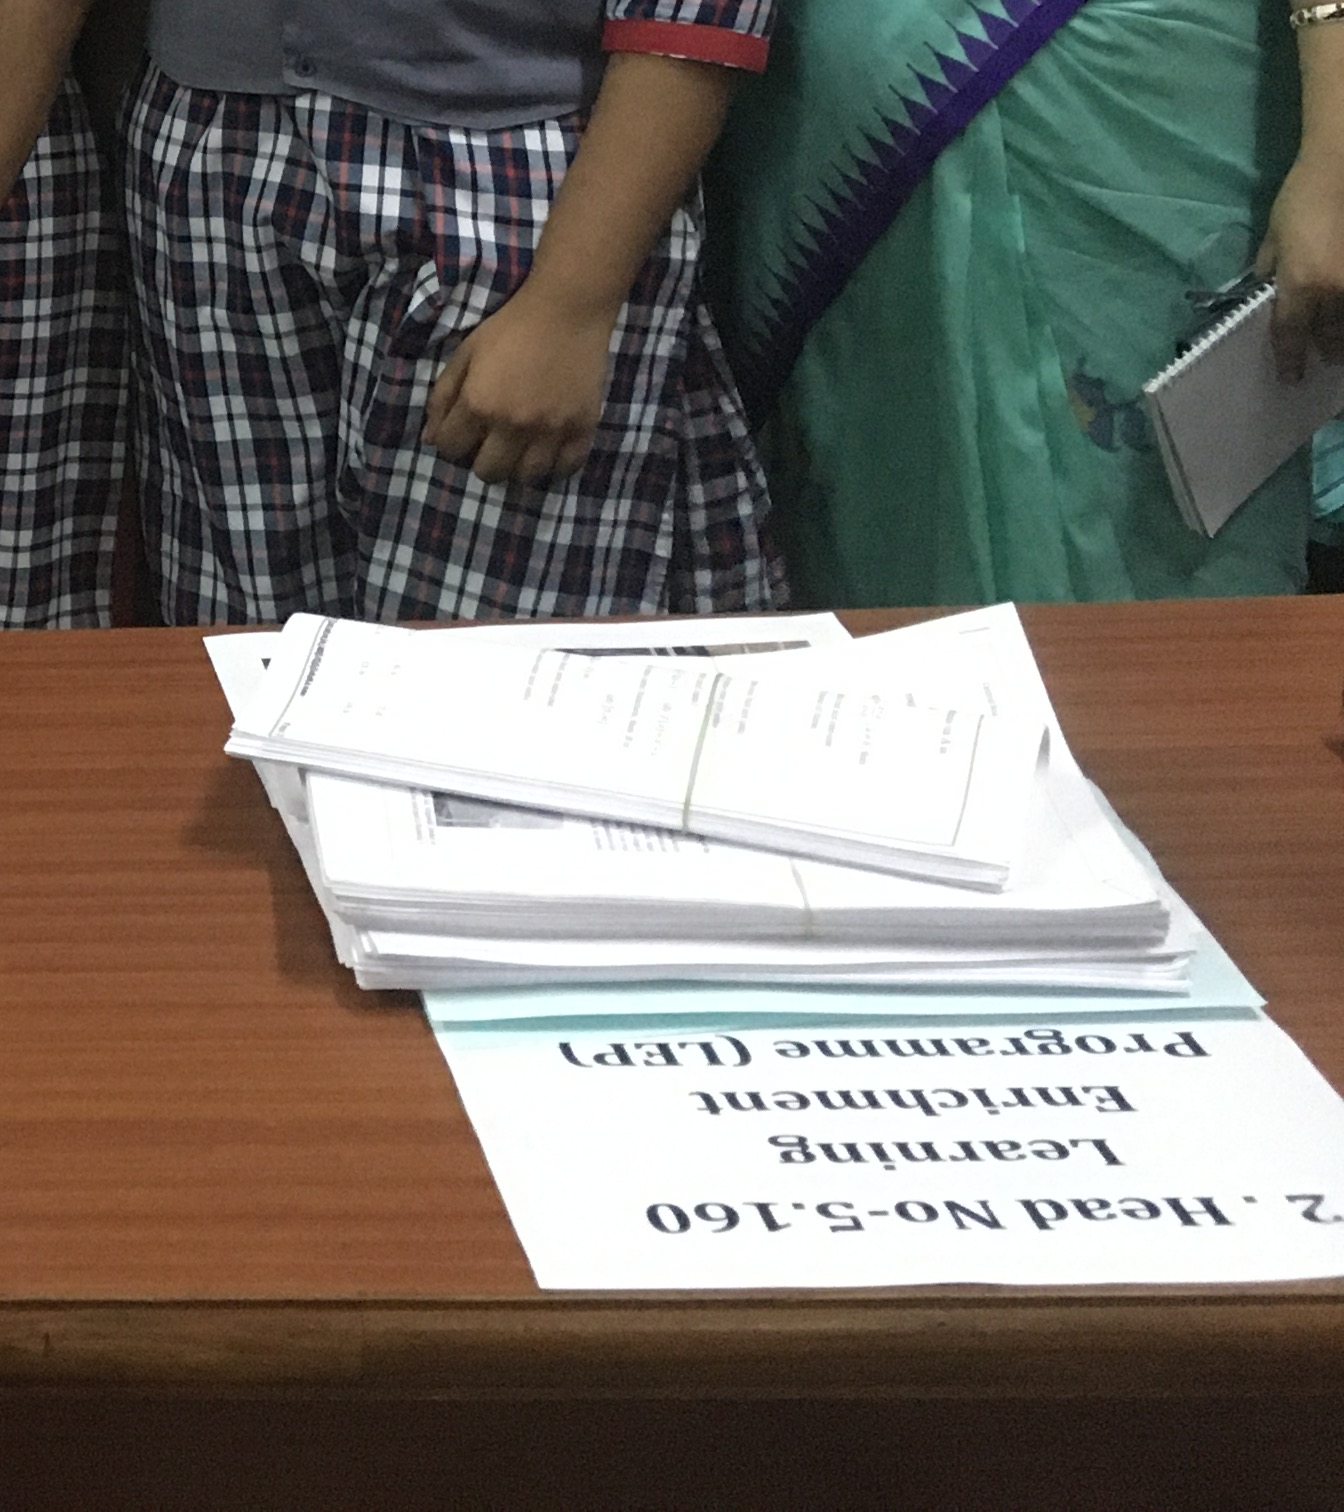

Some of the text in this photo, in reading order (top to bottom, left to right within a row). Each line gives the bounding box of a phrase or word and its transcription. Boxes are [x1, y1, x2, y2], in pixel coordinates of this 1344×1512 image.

[558, 1027, 1212, 1068] Programme (LEP)
[687, 1083, 1139, 1117] Enrichment
[766, 1132, 1126, 1172] Learning
[644, 1198, 1007, 1237] No-5.160
[1023, 1194, 1236, 1231] Head
[1285, 1193, 1344, 1225] 2
